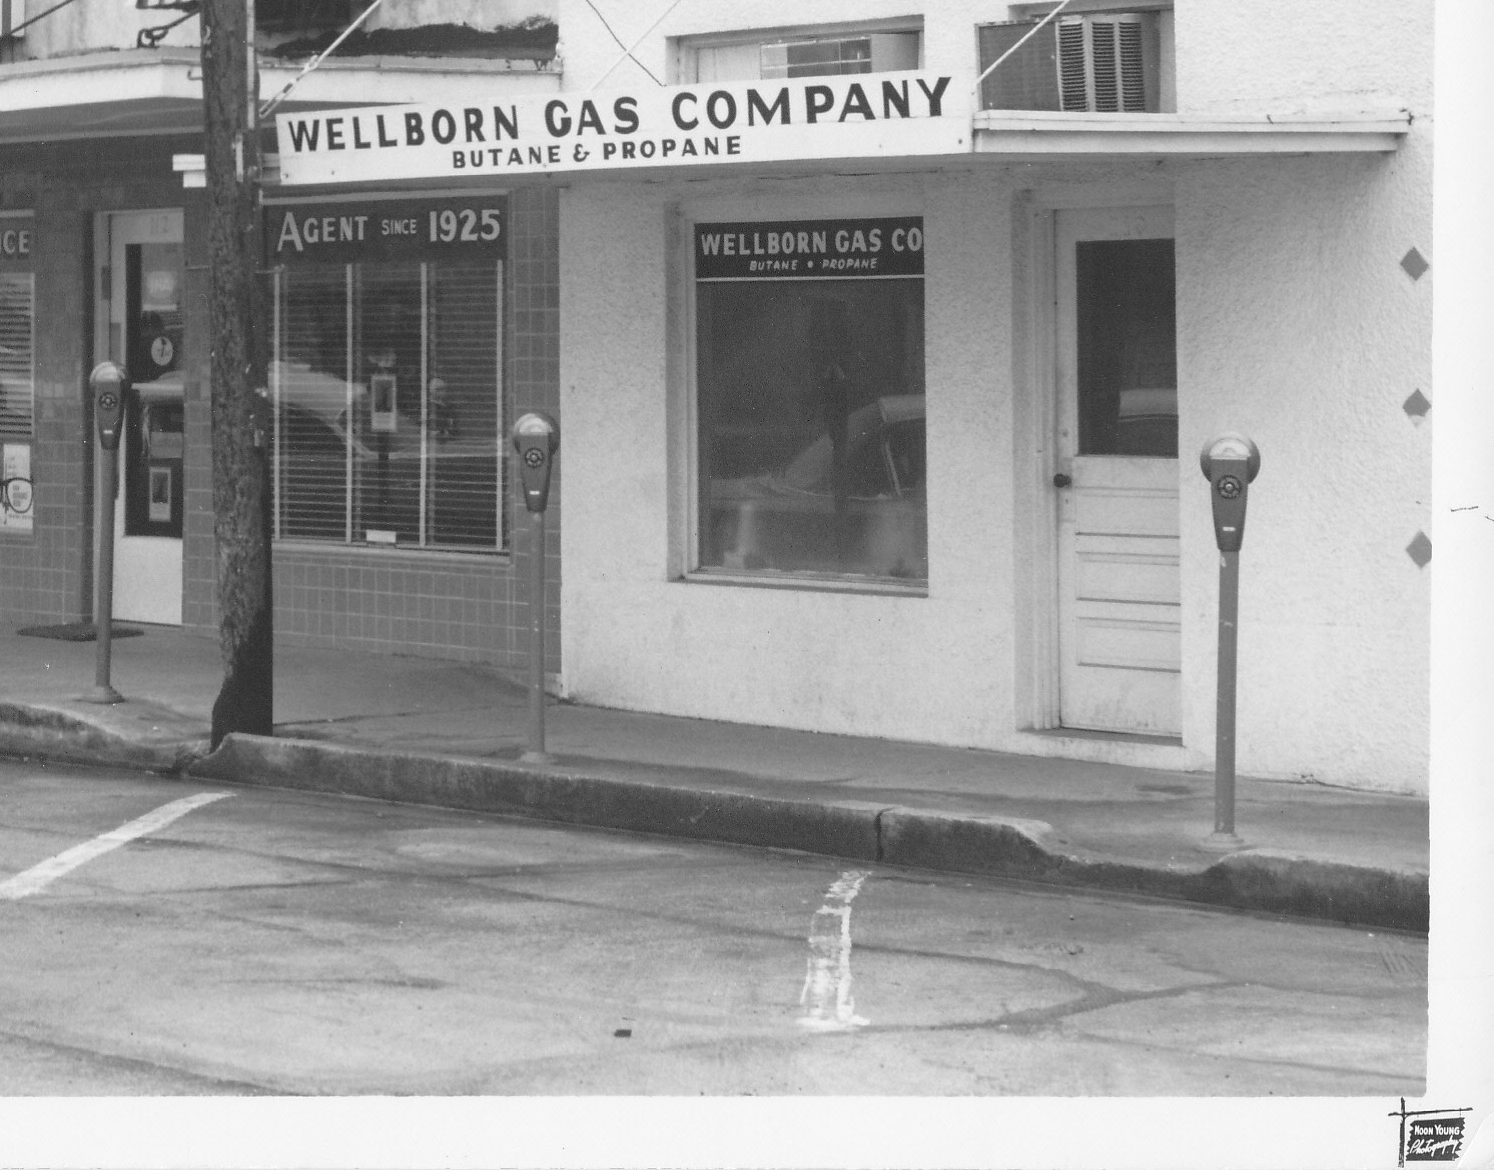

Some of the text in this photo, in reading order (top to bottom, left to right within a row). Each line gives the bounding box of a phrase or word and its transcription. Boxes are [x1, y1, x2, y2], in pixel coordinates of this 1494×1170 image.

[288, 76, 952, 153] WELLBORN GAS COMPANY
[452, 135, 742, 169] BUTANE & PROPANE
[381, 219, 417, 236] SINCE
[429, 208, 500, 243] 1925
[701, 227, 923, 256] WELLBORN GAS CO
[749, 257, 878, 271] BUTANE PROPANE
